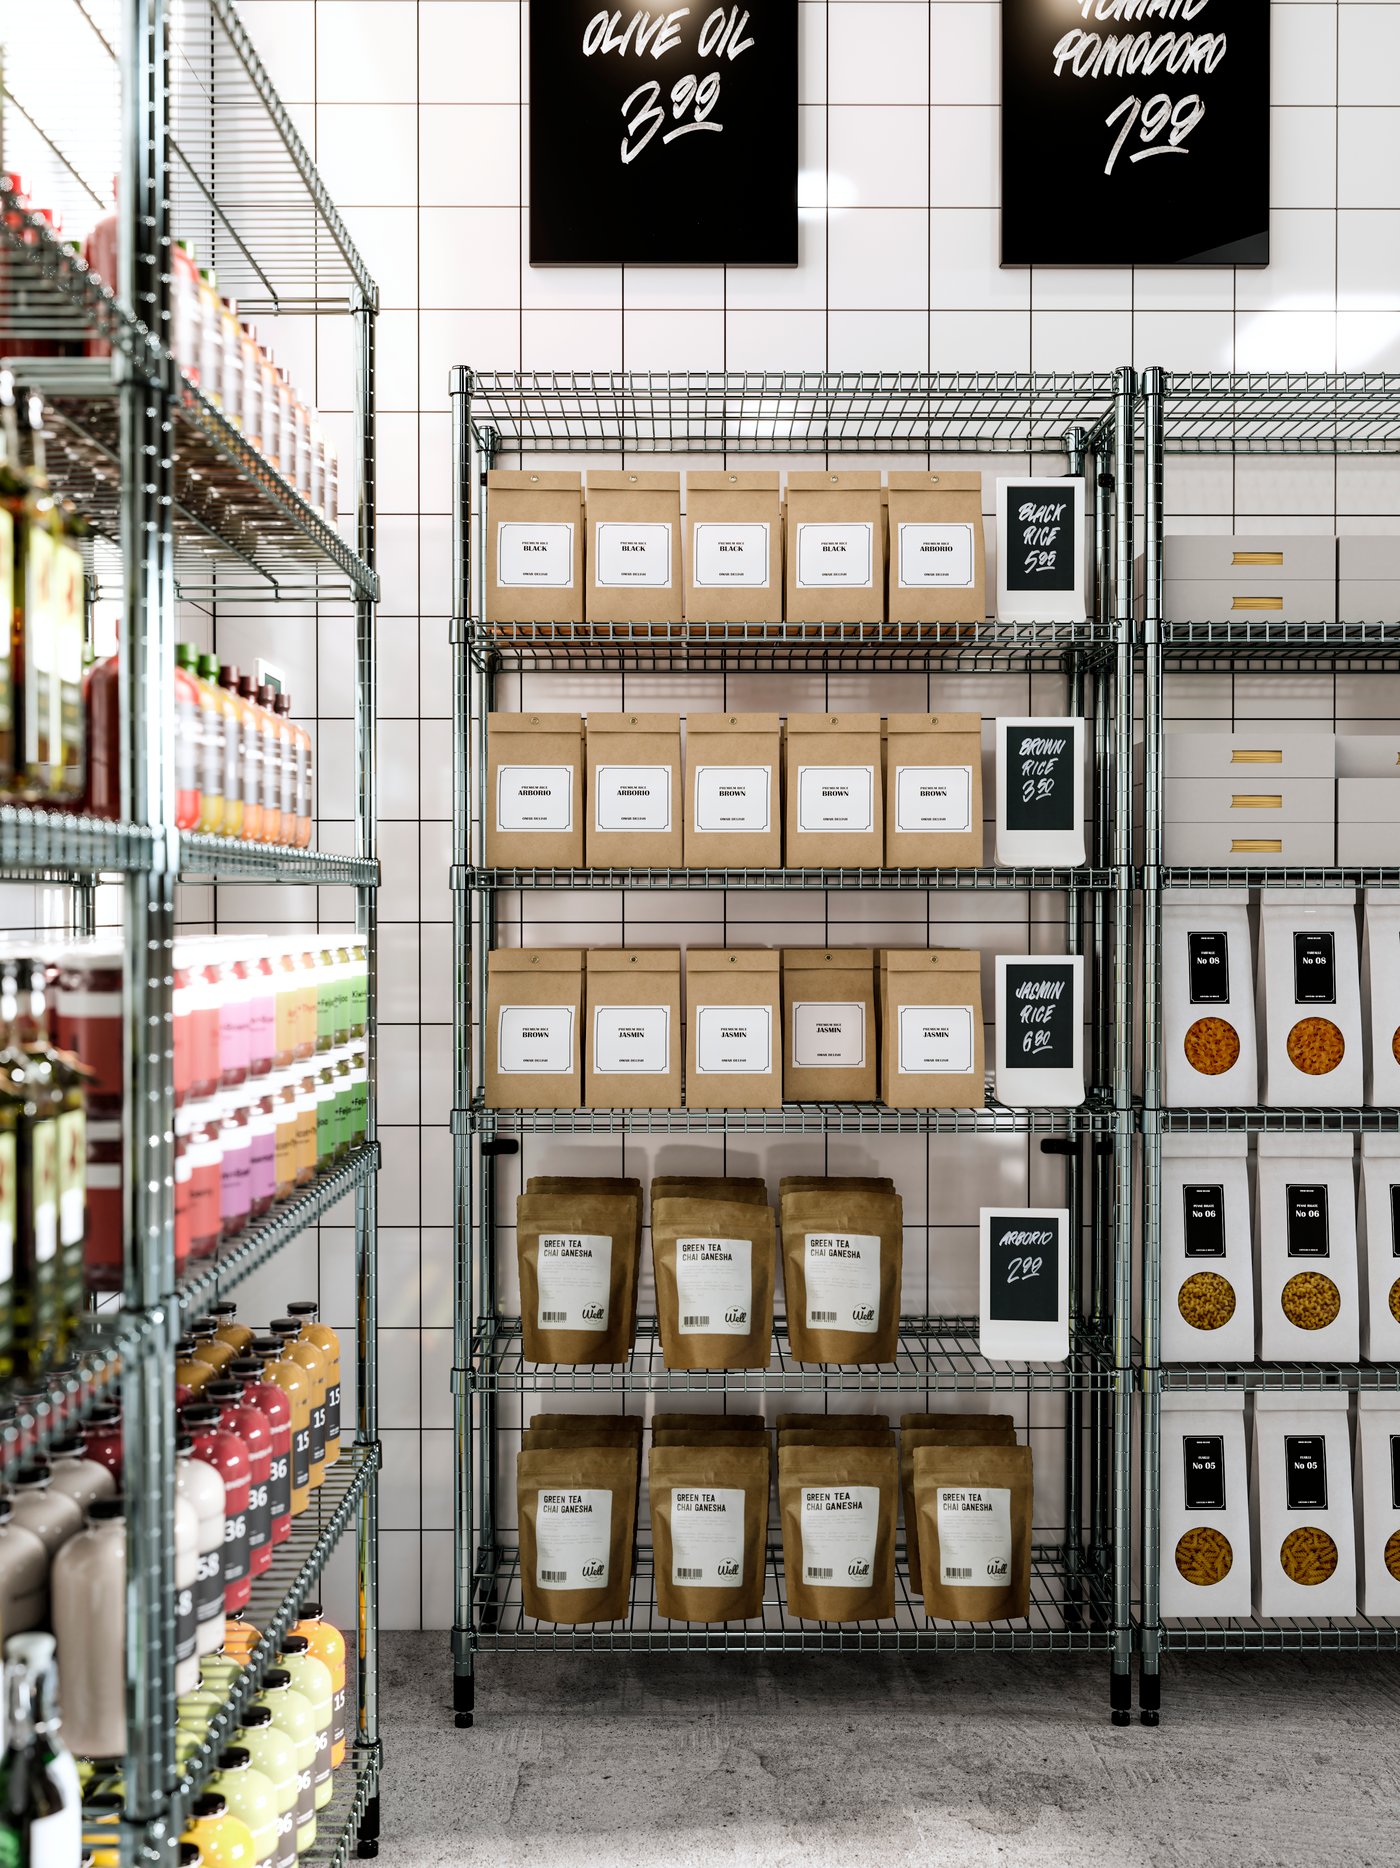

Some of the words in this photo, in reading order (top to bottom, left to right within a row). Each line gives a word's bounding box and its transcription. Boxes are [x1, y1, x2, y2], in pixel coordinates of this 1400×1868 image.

[583, 8, 690, 59] OLIVE
[698, 5, 755, 61] OIL
[1053, 28, 1227, 79] POMODORO
[1018, 502, 1067, 523] BLACK
[1023, 526, 1061, 546] RICE
[1019, 738, 1066, 756] BROWN
[1022, 758, 1059, 776] RICE
[1015, 980, 1066, 1000] JASMIN
[1020, 1004, 1056, 1024] RICE
[544, 1239, 565, 1247] GREEN
[569, 1239, 581, 1247] TEA
[811, 1238, 832, 1247] GREEN
[836, 1239, 849, 1248] TEA
[999, 1230, 1053, 1247] ARBORIO
[544, 1248, 558, 1256] CHAI
[561, 1248, 592, 1257] GANESHA
[683, 1243, 704, 1252] GREEN
[708, 1243, 721, 1251] TEA
[811, 1248, 826, 1256] CHAI
[829, 1248, 861, 1258] GANESHA
[683, 1252, 698, 1261] CHAI
[701, 1252, 732, 1261] GANESHA
[582, 1309, 604, 1319] Well
[725, 1311, 747, 1323] Well
[853, 1309, 875, 1320] Well
[329, 1388, 340, 1407] 15
[313, 1408, 325, 1429] 15
[296, 1431, 309, 1452] 15
[270, 1459, 287, 1481] 36
[248, 1486, 267, 1510] 36
[544, 1495, 565, 1503] GREEN
[569, 1495, 581, 1503] TEA
[677, 1493, 698, 1501] GREEN
[702, 1493, 715, 1502] TEA
[807, 1492, 830, 1501] GREEN
[834, 1491, 850, 1500] TEA
[943, 1493, 965, 1501] GREEN
[969, 1493, 982, 1501] TEA
[543, 1504, 558, 1513] CHAI
[561, 1504, 592, 1513] GANESHA
[677, 1502, 692, 1511] CHAI
[695, 1503, 726, 1512] GANESHA
[807, 1502, 822, 1510] CHAI
[826, 1501, 862, 1510] GANESHA
[943, 1502, 958, 1510] CHAI
[962, 1502, 992, 1511] GANESHA
[224, 1516, 246, 1542] 36
[582, 1565, 605, 1576] Well
[718, 1564, 739, 1575] Well
[848, 1564, 870, 1575] Well
[987, 1563, 1008, 1575] Well
[176, 1590, 193, 1616] 8
[334, 1690, 345, 1711] 15
